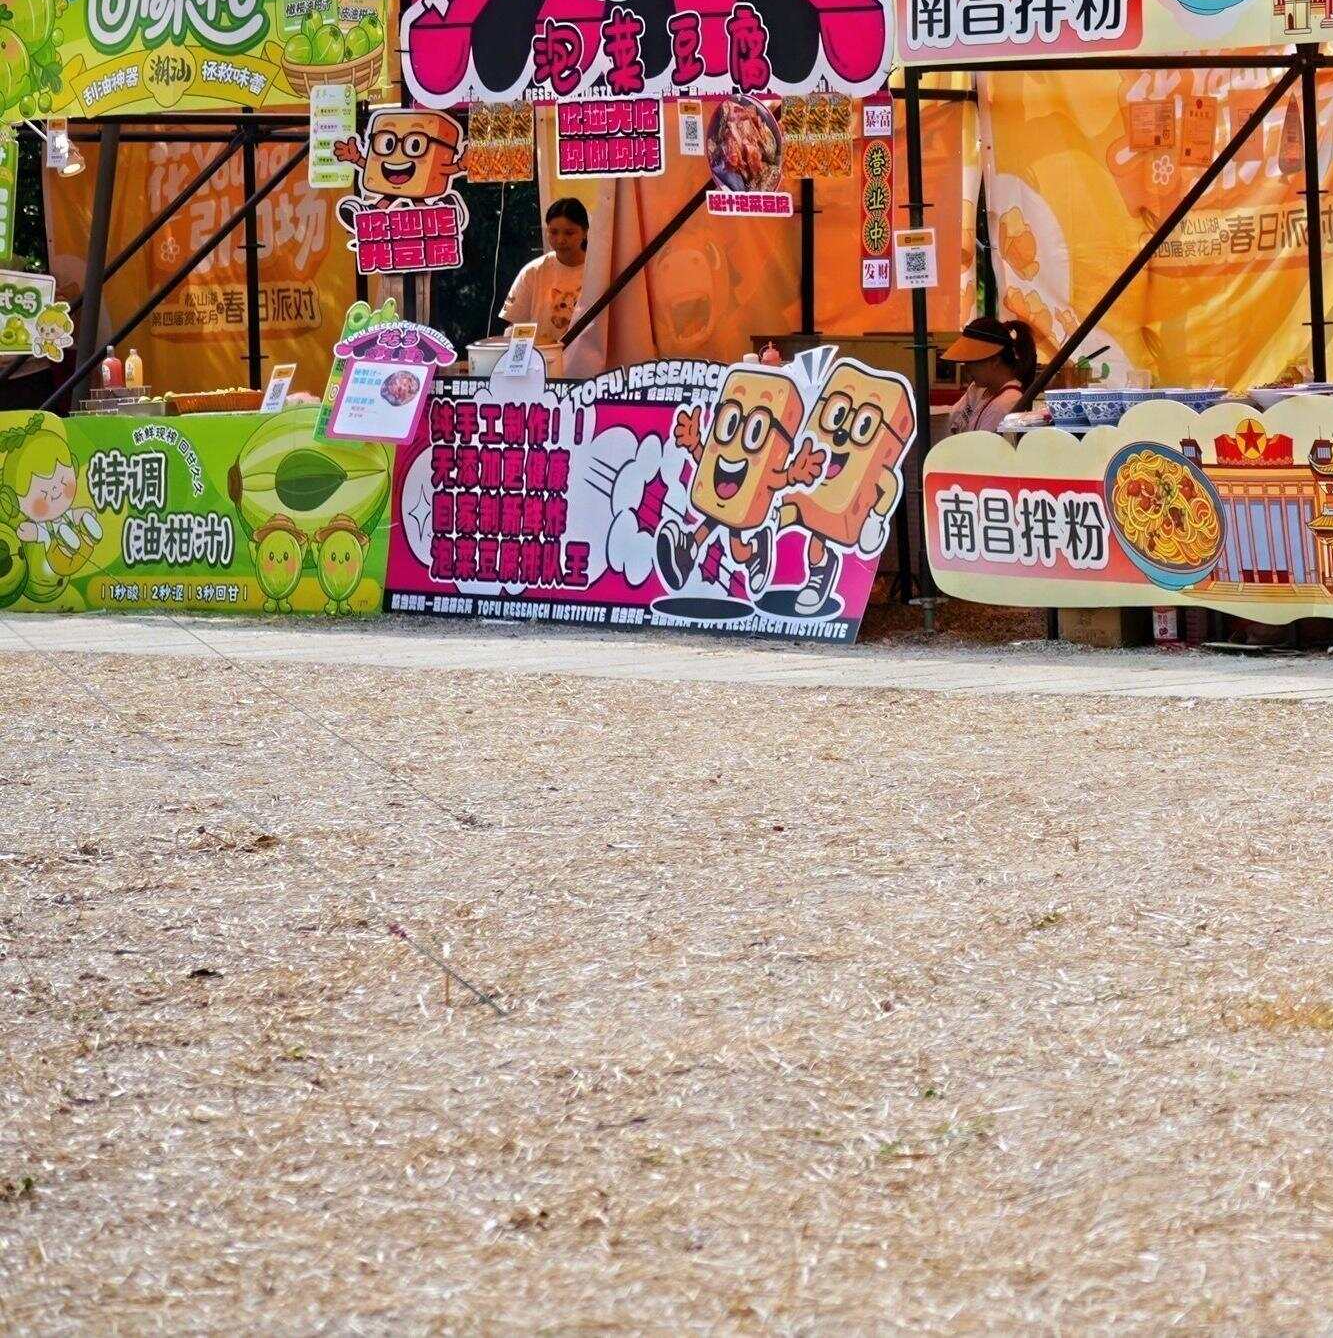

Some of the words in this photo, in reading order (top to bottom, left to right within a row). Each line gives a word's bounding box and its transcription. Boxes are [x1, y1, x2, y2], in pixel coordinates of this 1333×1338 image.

[534, 8, 772, 94] 泡菜豆腐
[82, 64, 140, 108] 刮油神器
[149, 54, 193, 86] 潮汕
[199, 59, 268, 97] 拯救味蕾
[560, 99, 660, 136] 欢迎光临
[865, 110, 891, 128] 暴富
[868, 149, 887, 250] 营业中
[1152, 238, 1223, 259] 四届赏花月
[864, 263, 889, 281] 发财
[570, 368, 624, 409] TOFU
[89, 451, 166, 510] 特调
[133, 425, 179, 446] 新鲜现榨
[178, 439, 205, 498] 回甘久久
[123, 513, 233, 564] (油柑汁)
[940, 490, 1103, 562] 南昌拌粉
[109, 583, 139, 602] 1秒酸
[151, 584, 185, 602] 2秒涩
[195, 584, 240, 602] 3秒回甘
[477, 599, 502, 616] TOFU
[503, 601, 551, 620] RESEARCH
[552, 604, 608, 623] INSTITUTE
[784, 620, 850, 639] INSTITUTE
